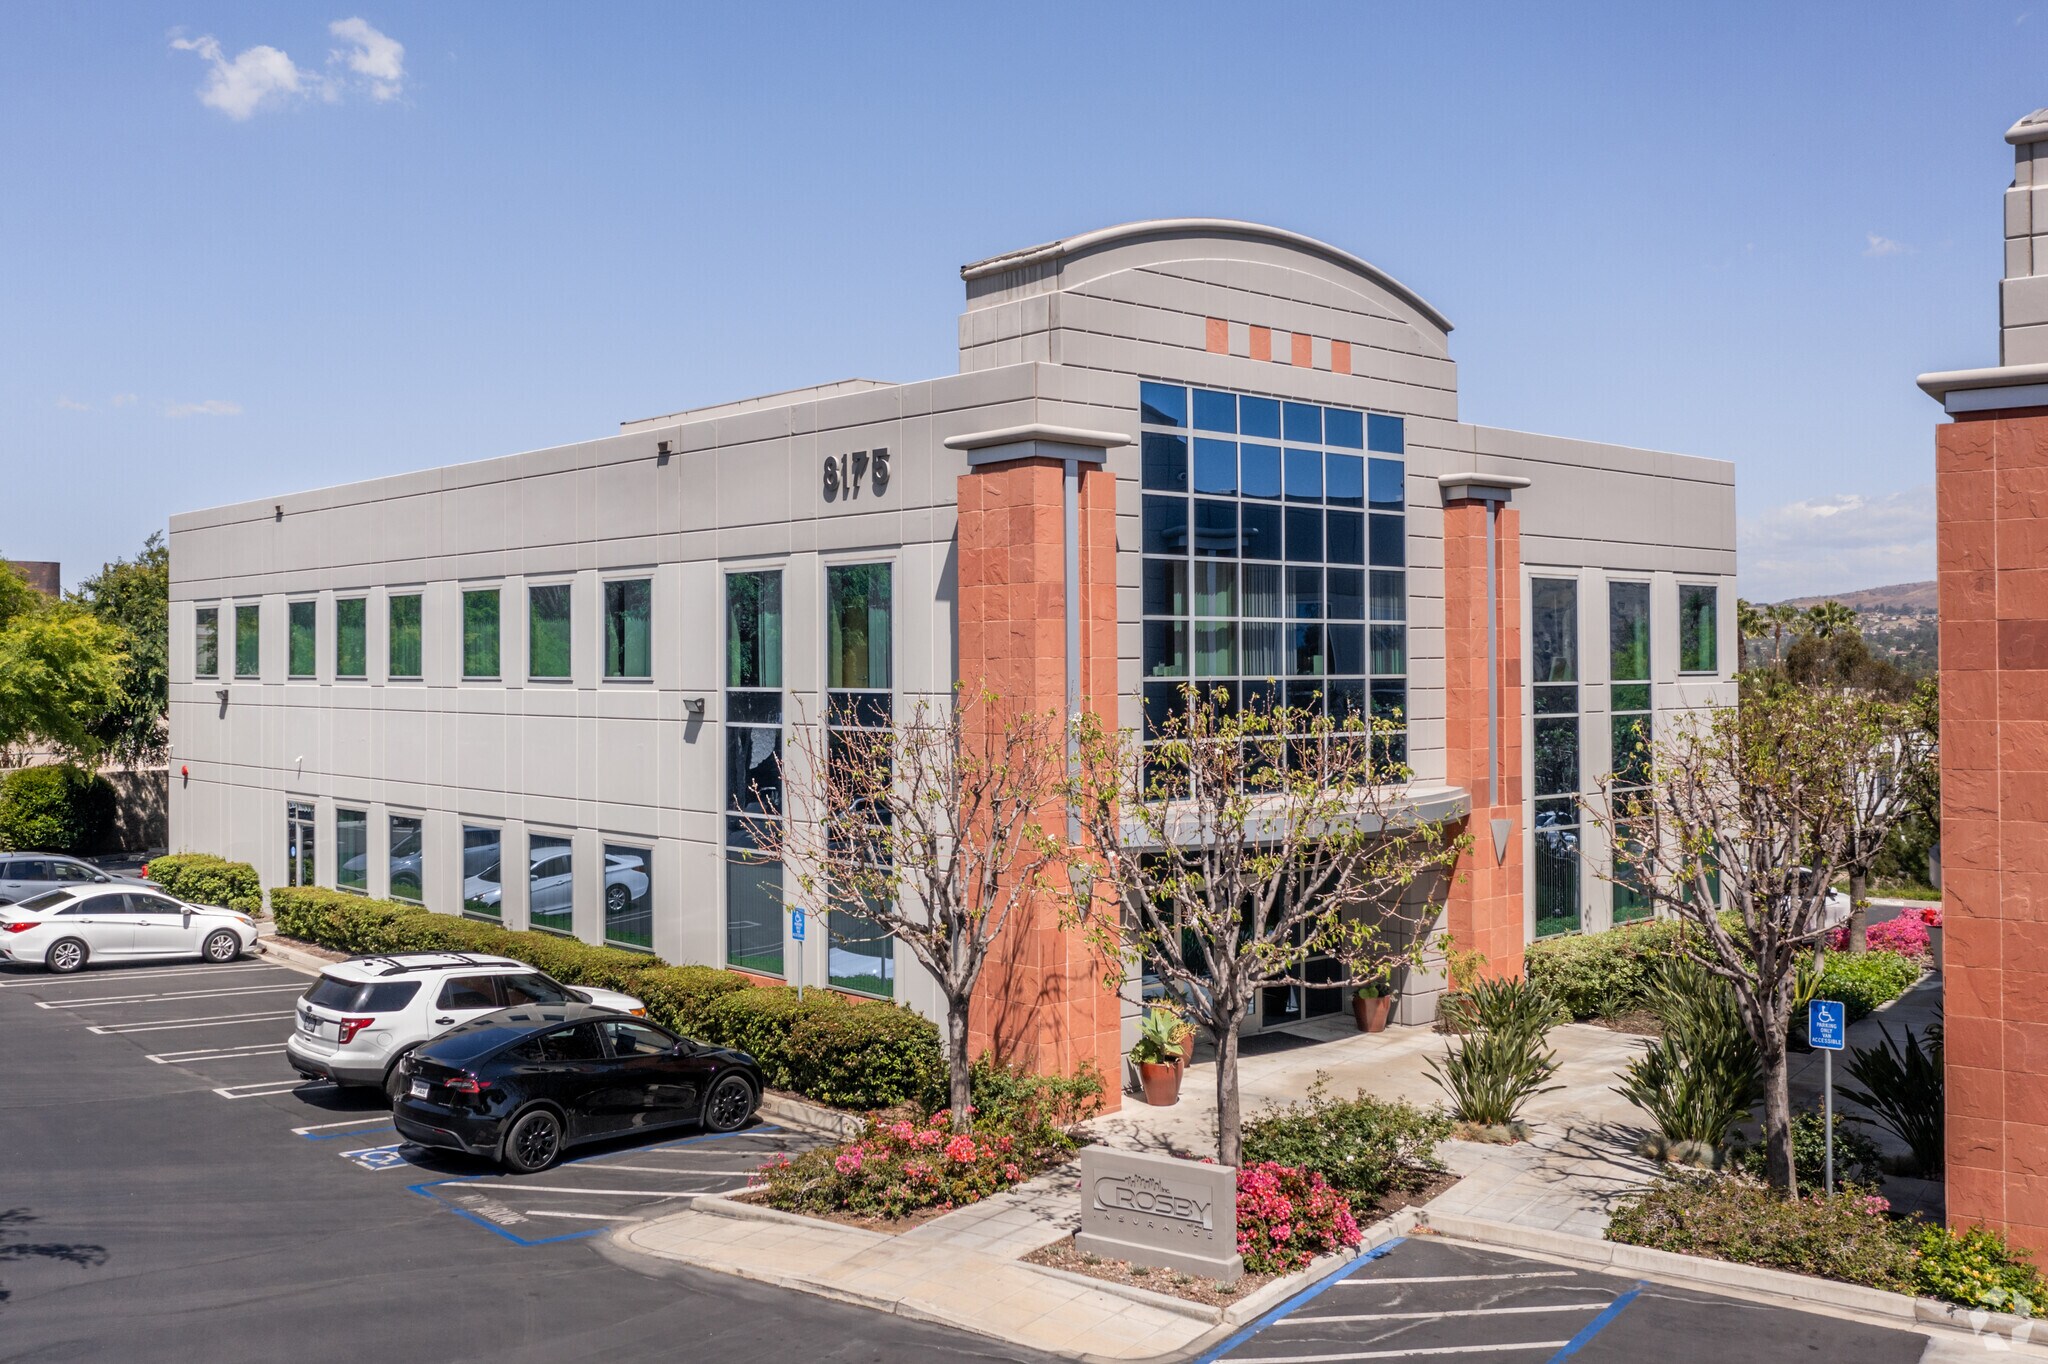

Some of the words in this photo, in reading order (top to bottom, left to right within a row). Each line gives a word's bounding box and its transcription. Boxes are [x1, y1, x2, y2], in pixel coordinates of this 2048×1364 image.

[823, 448, 890, 493] 8175
[1812, 1037, 1841, 1045] ACCESSIBLE
[1094, 1176, 1211, 1222] CROSBY
